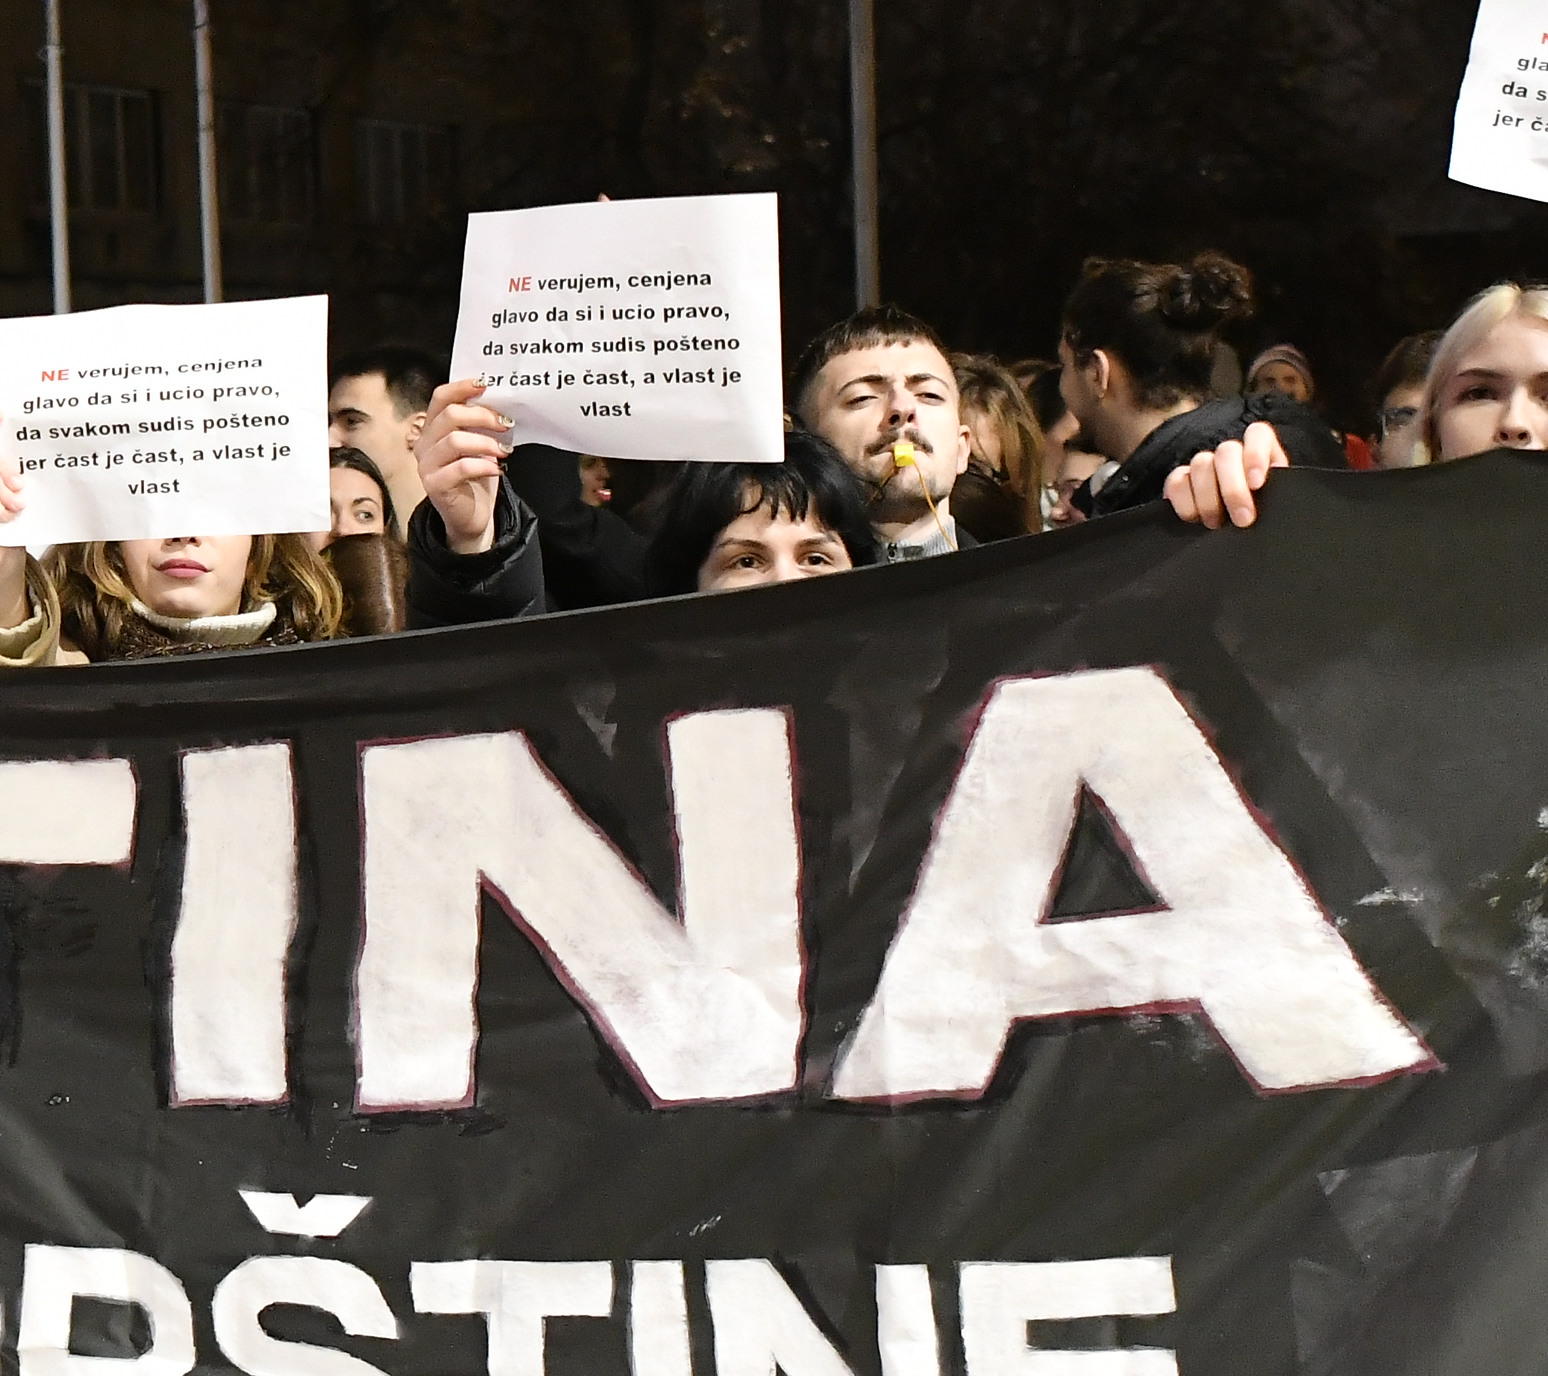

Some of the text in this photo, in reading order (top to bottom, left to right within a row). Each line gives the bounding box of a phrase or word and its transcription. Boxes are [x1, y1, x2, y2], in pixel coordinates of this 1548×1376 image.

[1501, 81, 1528, 99] da
[1492, 109, 1525, 128] jer
[508, 270, 712, 294] NE verujem, cenjena
[491, 304, 730, 329] glavo da si i ucio pravo,
[482, 335, 740, 356] da svakom sudis pošteno
[41, 358, 263, 382] NE verujem, cenjena
[509, 370, 551, 387] čast
[556, 370, 576, 390] je
[582, 369, 635, 388] čast,
[643, 372, 655, 384] a
[662, 367, 715, 384] vlast
[721, 367, 742, 388] je
[23, 385, 280, 415] glavo da si i ucio pravo,
[579, 401, 632, 417] vlast
[16, 413, 290, 442] da svakom sudis pošteno
[18, 442, 291, 475] jer čast je čast, a vlast je
[127, 479, 180, 495] vlast
